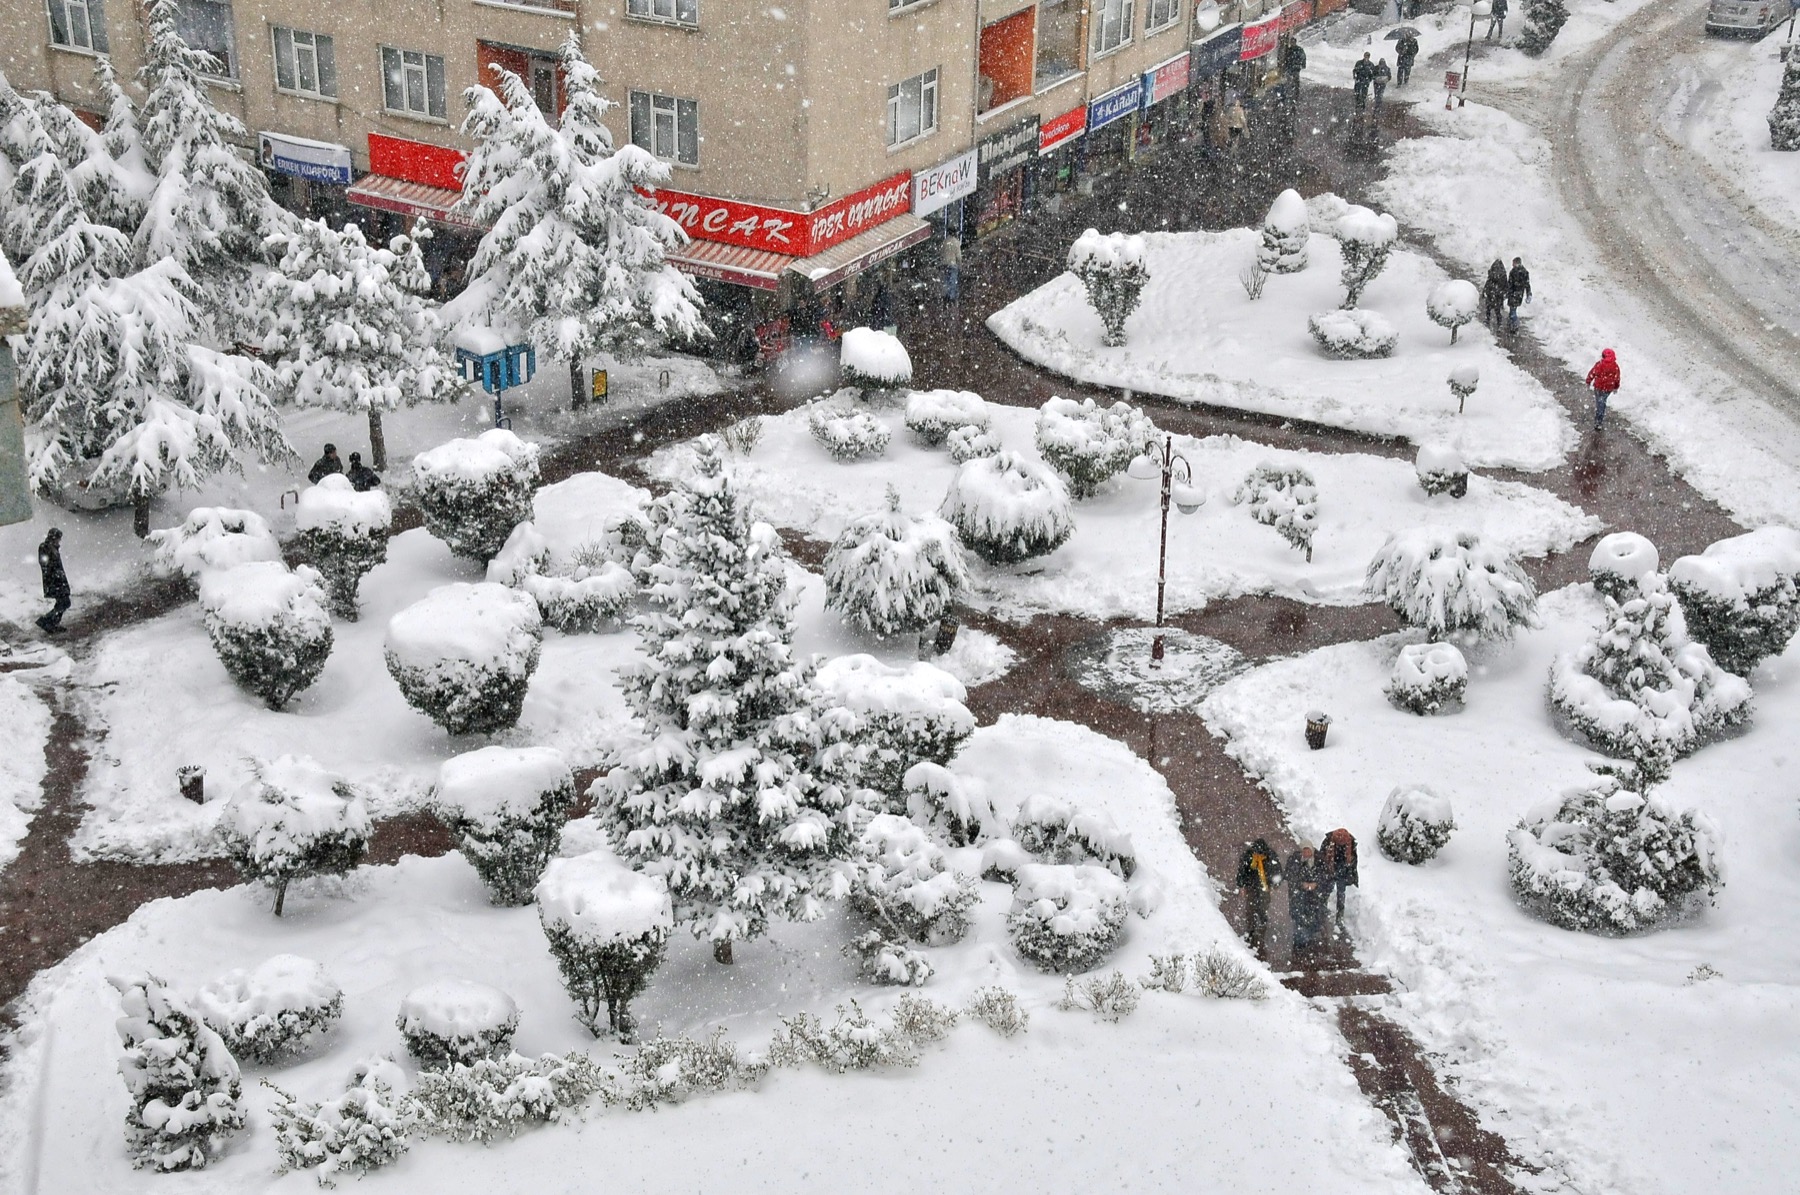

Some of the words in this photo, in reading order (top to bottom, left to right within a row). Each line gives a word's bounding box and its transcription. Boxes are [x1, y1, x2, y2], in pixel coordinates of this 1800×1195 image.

[277, 159, 300, 174] ERKEK
[847, 179, 911, 229] OYUNCAK
[663, 260, 723, 278] YUNCAK
